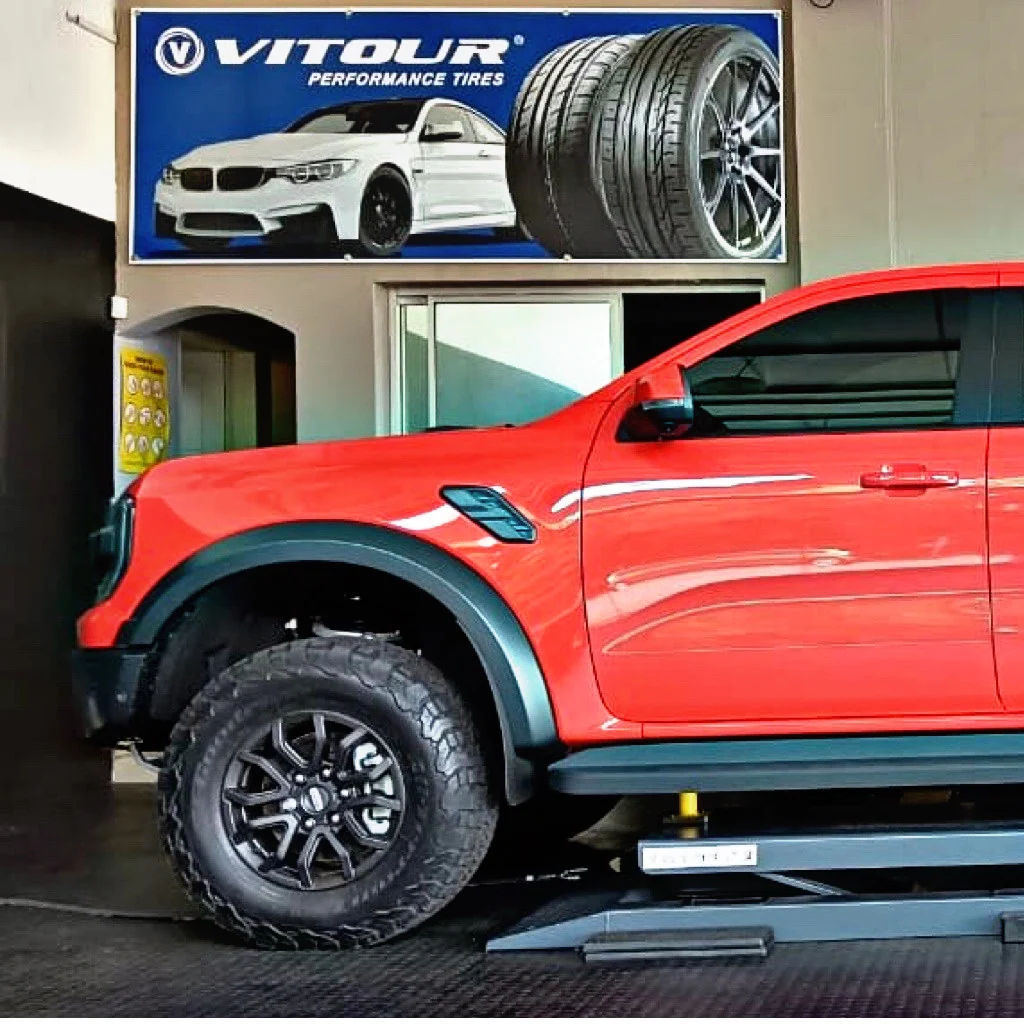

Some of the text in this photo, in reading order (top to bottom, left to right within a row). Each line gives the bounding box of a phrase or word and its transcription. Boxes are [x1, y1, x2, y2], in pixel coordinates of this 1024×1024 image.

[214, 39, 510, 65] VITOUR
[308, 72, 504, 87] PERFORMANCE TIRES
